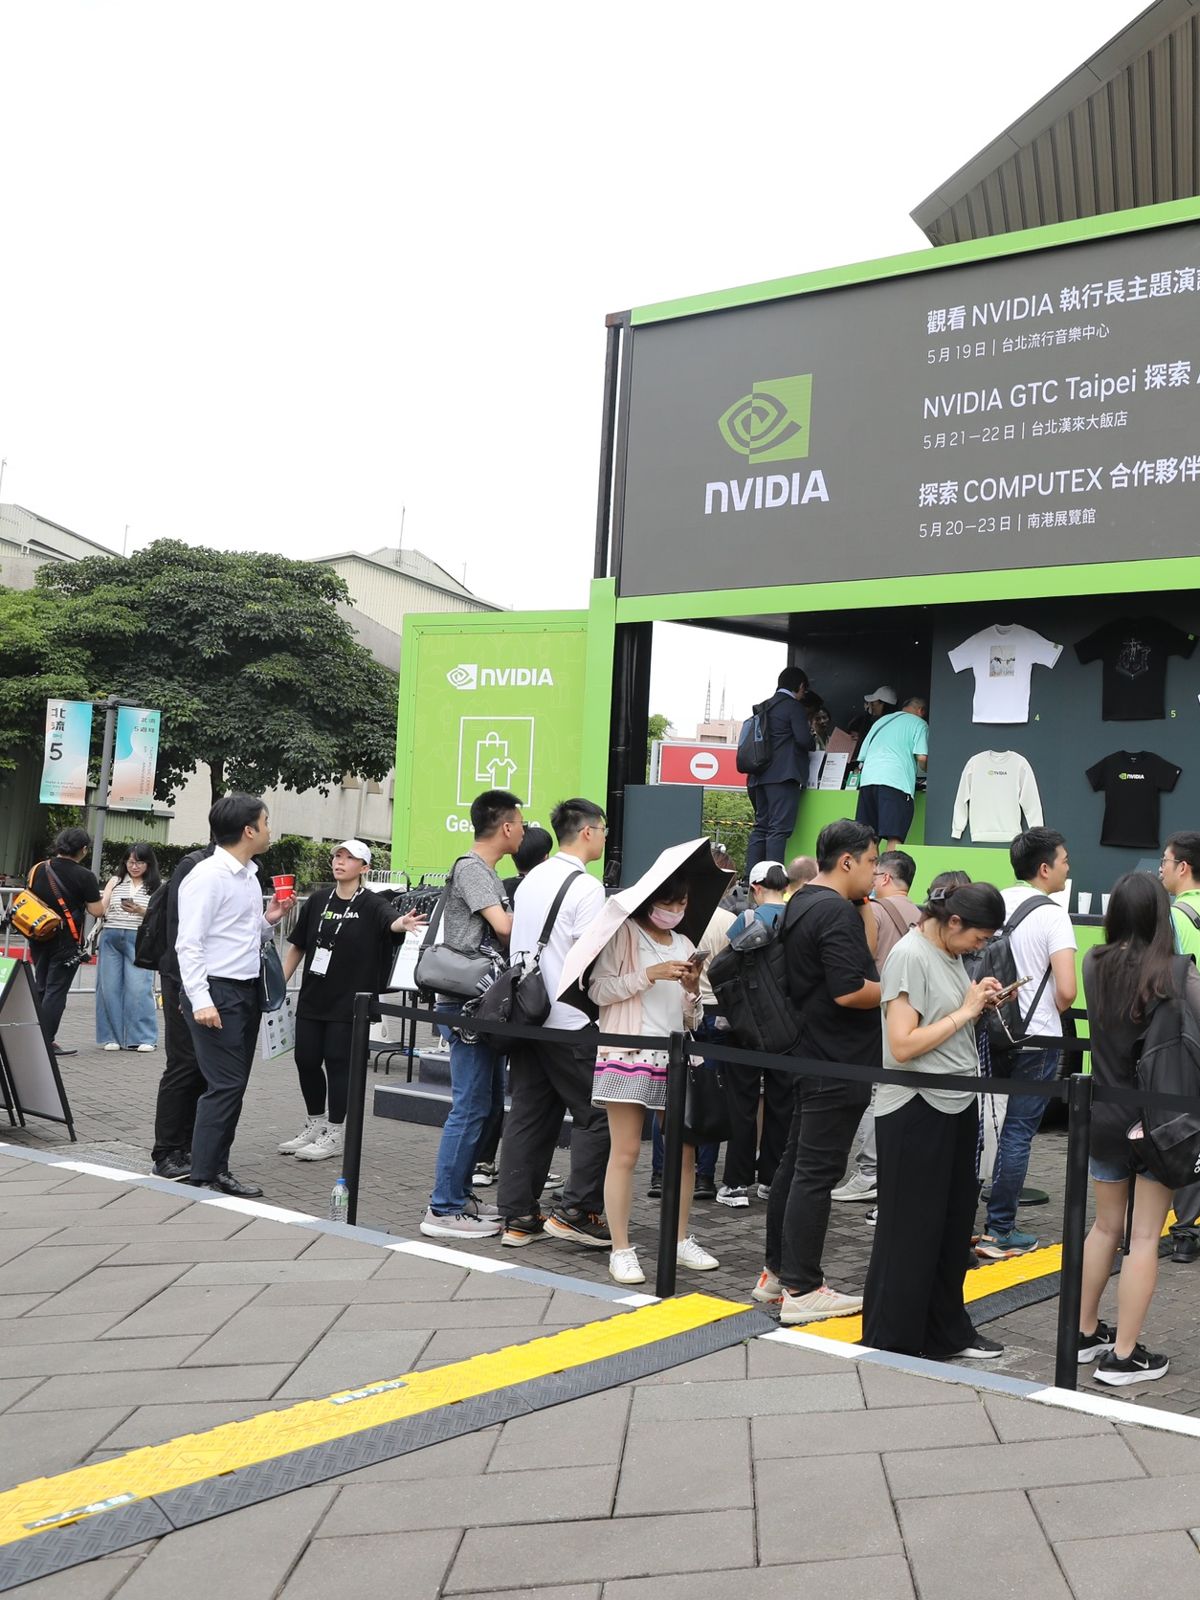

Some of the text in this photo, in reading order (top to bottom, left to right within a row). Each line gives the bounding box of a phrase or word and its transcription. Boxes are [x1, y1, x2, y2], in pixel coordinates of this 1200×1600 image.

[927, 305, 966, 334] 觀看
[972, 293, 1054, 327] NVIDIA
[1002, 323, 1110, 353] 台北流行音樂中心
[923, 387, 1003, 420] NVIDIA
[1010, 379, 1059, 408] GTC
[1065, 368, 1137, 403] Taipei
[1144, 360, 1191, 391] 探索
[1031, 410, 1128, 437] 台北漢來大飯店
[918, 480, 959, 508] 探索
[963, 466, 1104, 503] COMPUTEX
[1027, 507, 1096, 529] 南港展覽館
[49, 742, 63, 761] 5
[446, 814, 476, 832] Gea
